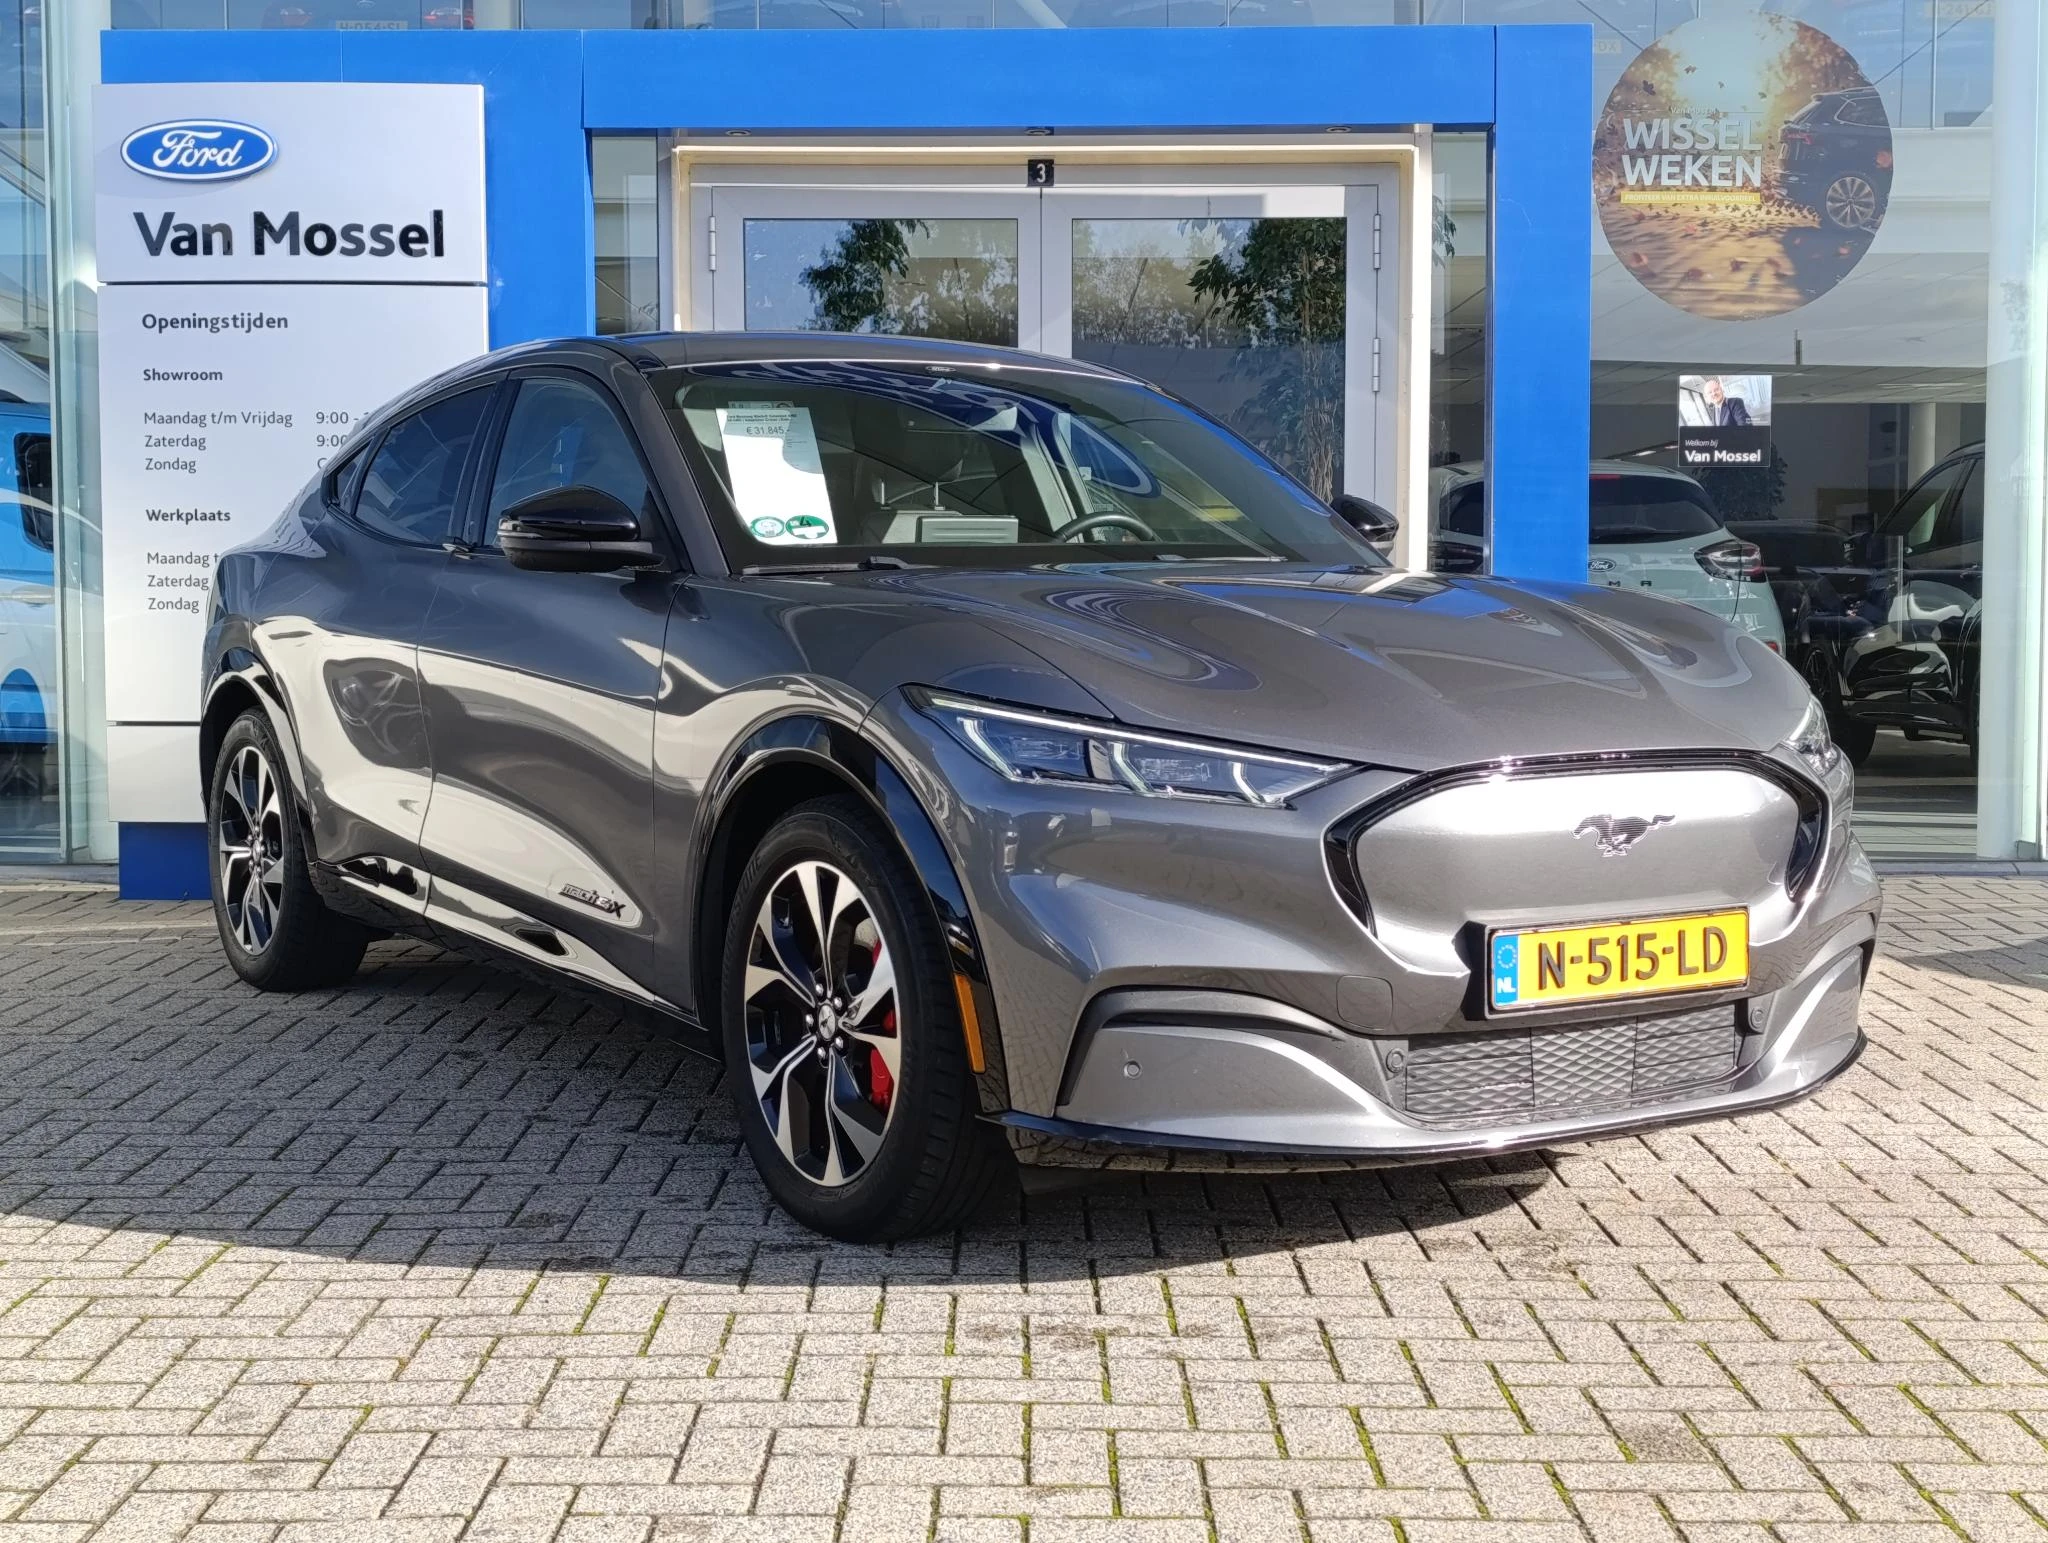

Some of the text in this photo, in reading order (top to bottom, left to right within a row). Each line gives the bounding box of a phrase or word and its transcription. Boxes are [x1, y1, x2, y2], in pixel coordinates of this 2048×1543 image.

[1623, 117, 1762, 150] WISSEL
[152, 129, 245, 168] Ford
[1036, 163, 1046, 183] 3
[1621, 155, 1762, 187] WEKEN
[133, 209, 444, 257] Van Mossel
[142, 312, 288, 334] Openingstijden
[143, 368, 223, 381] Showroom
[144, 411, 207, 427] Maandag
[211, 411, 237, 425] t/m
[241, 411, 293, 427] Vrijdag
[315, 411, 349, 424] 9:00
[144, 434, 206, 451] Zaterdag
[1685, 439, 1719, 448] Welkom bij
[1685, 449, 1761, 462] Van Mossel
[145, 457, 197, 474] Zondag
[145, 508, 231, 525] Werkplaats
[147, 552, 210, 568] Maandag
[147, 574, 209, 590] Zaterdag
[148, 597, 200, 613] Zondag
[1496, 926, 1728, 994] NL N-515-LD
